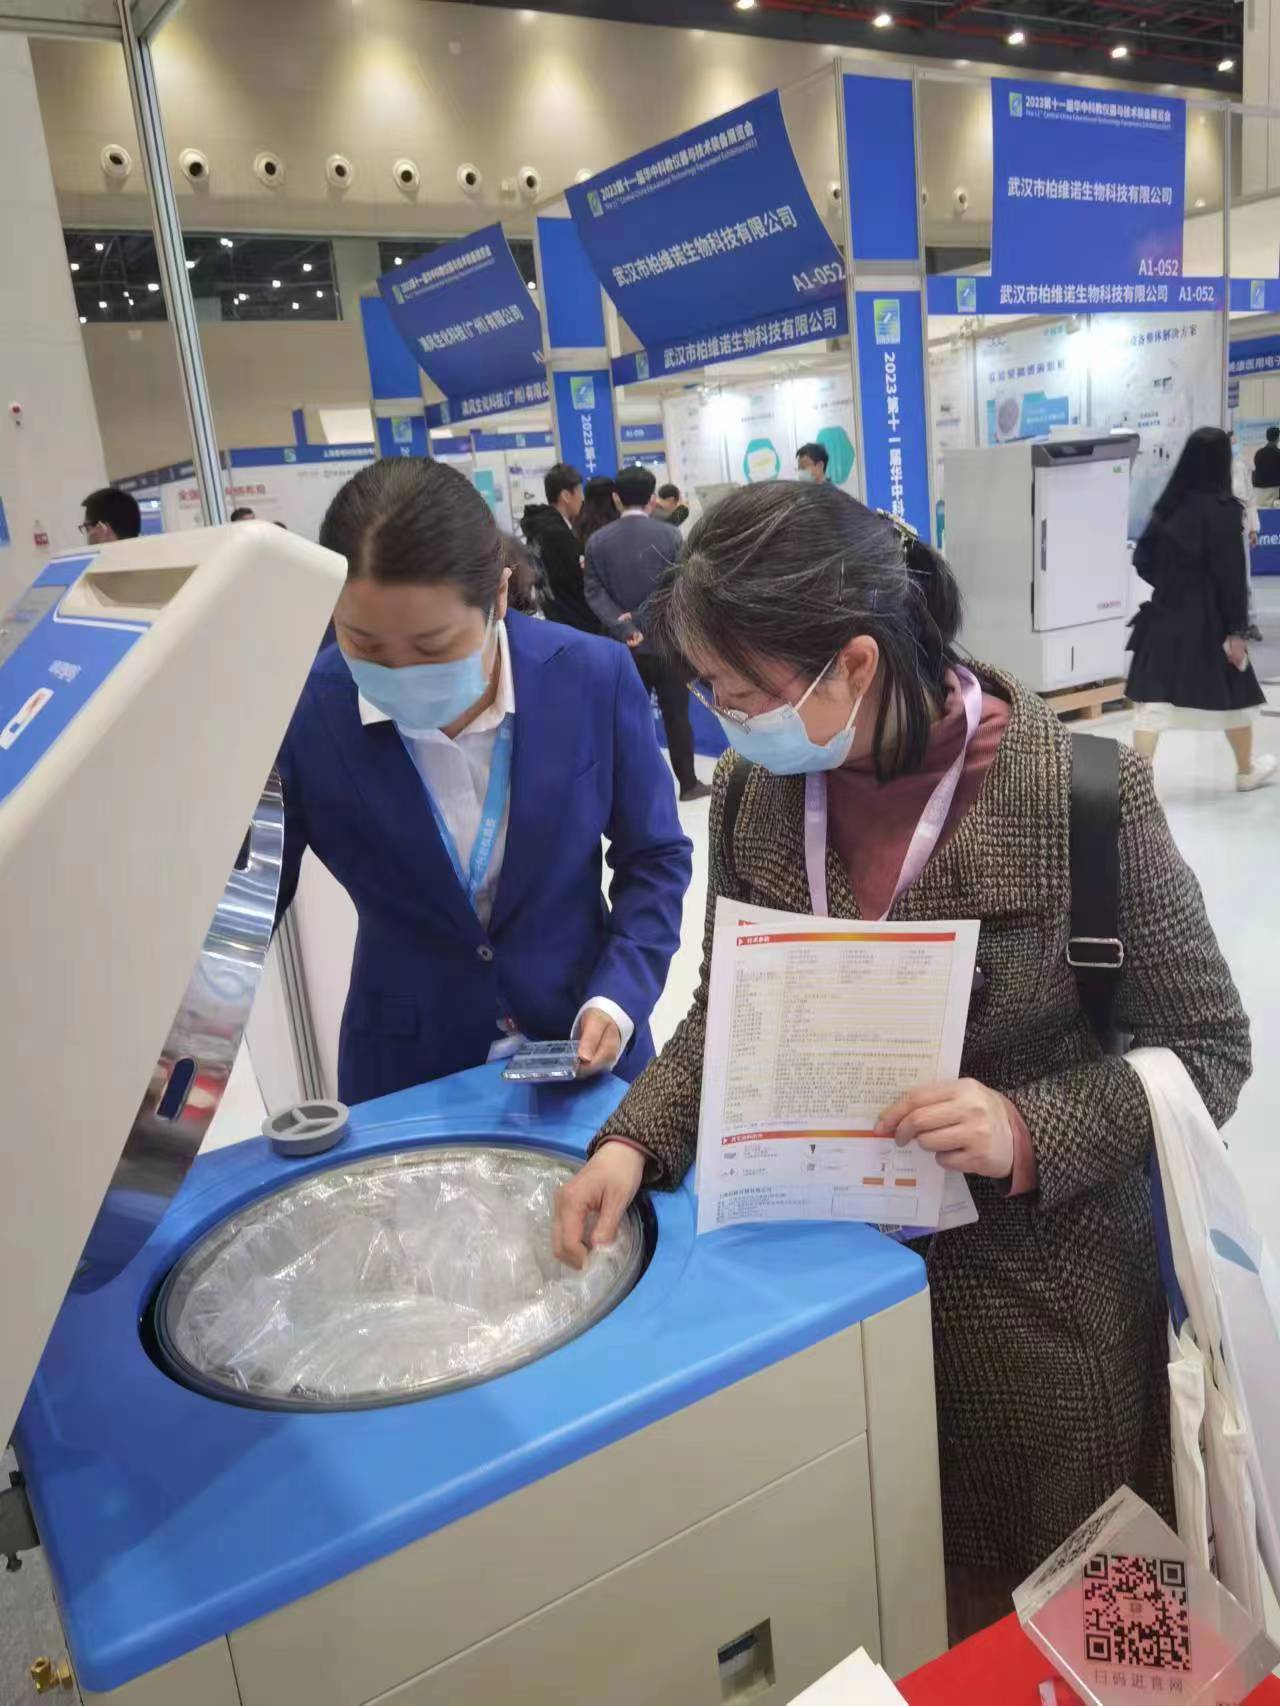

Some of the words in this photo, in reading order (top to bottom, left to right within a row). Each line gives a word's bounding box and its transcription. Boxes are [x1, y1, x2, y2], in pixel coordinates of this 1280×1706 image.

[1007, 176, 1173, 206] 武汉市柏维诺生物科技有限公司
[612, 205, 798, 287] 武汉市柏维诺生物科技有限公司
[792, 262, 846, 292] A1-052
[1138, 259, 1179, 276] A1-052
[1000, 284, 1168, 305] 武汉市柏维诺生物科技有限公司
[1178, 286, 1215, 301] A1-052
[664, 307, 837, 369] 武汉市柏维诺生物科技有限公司
